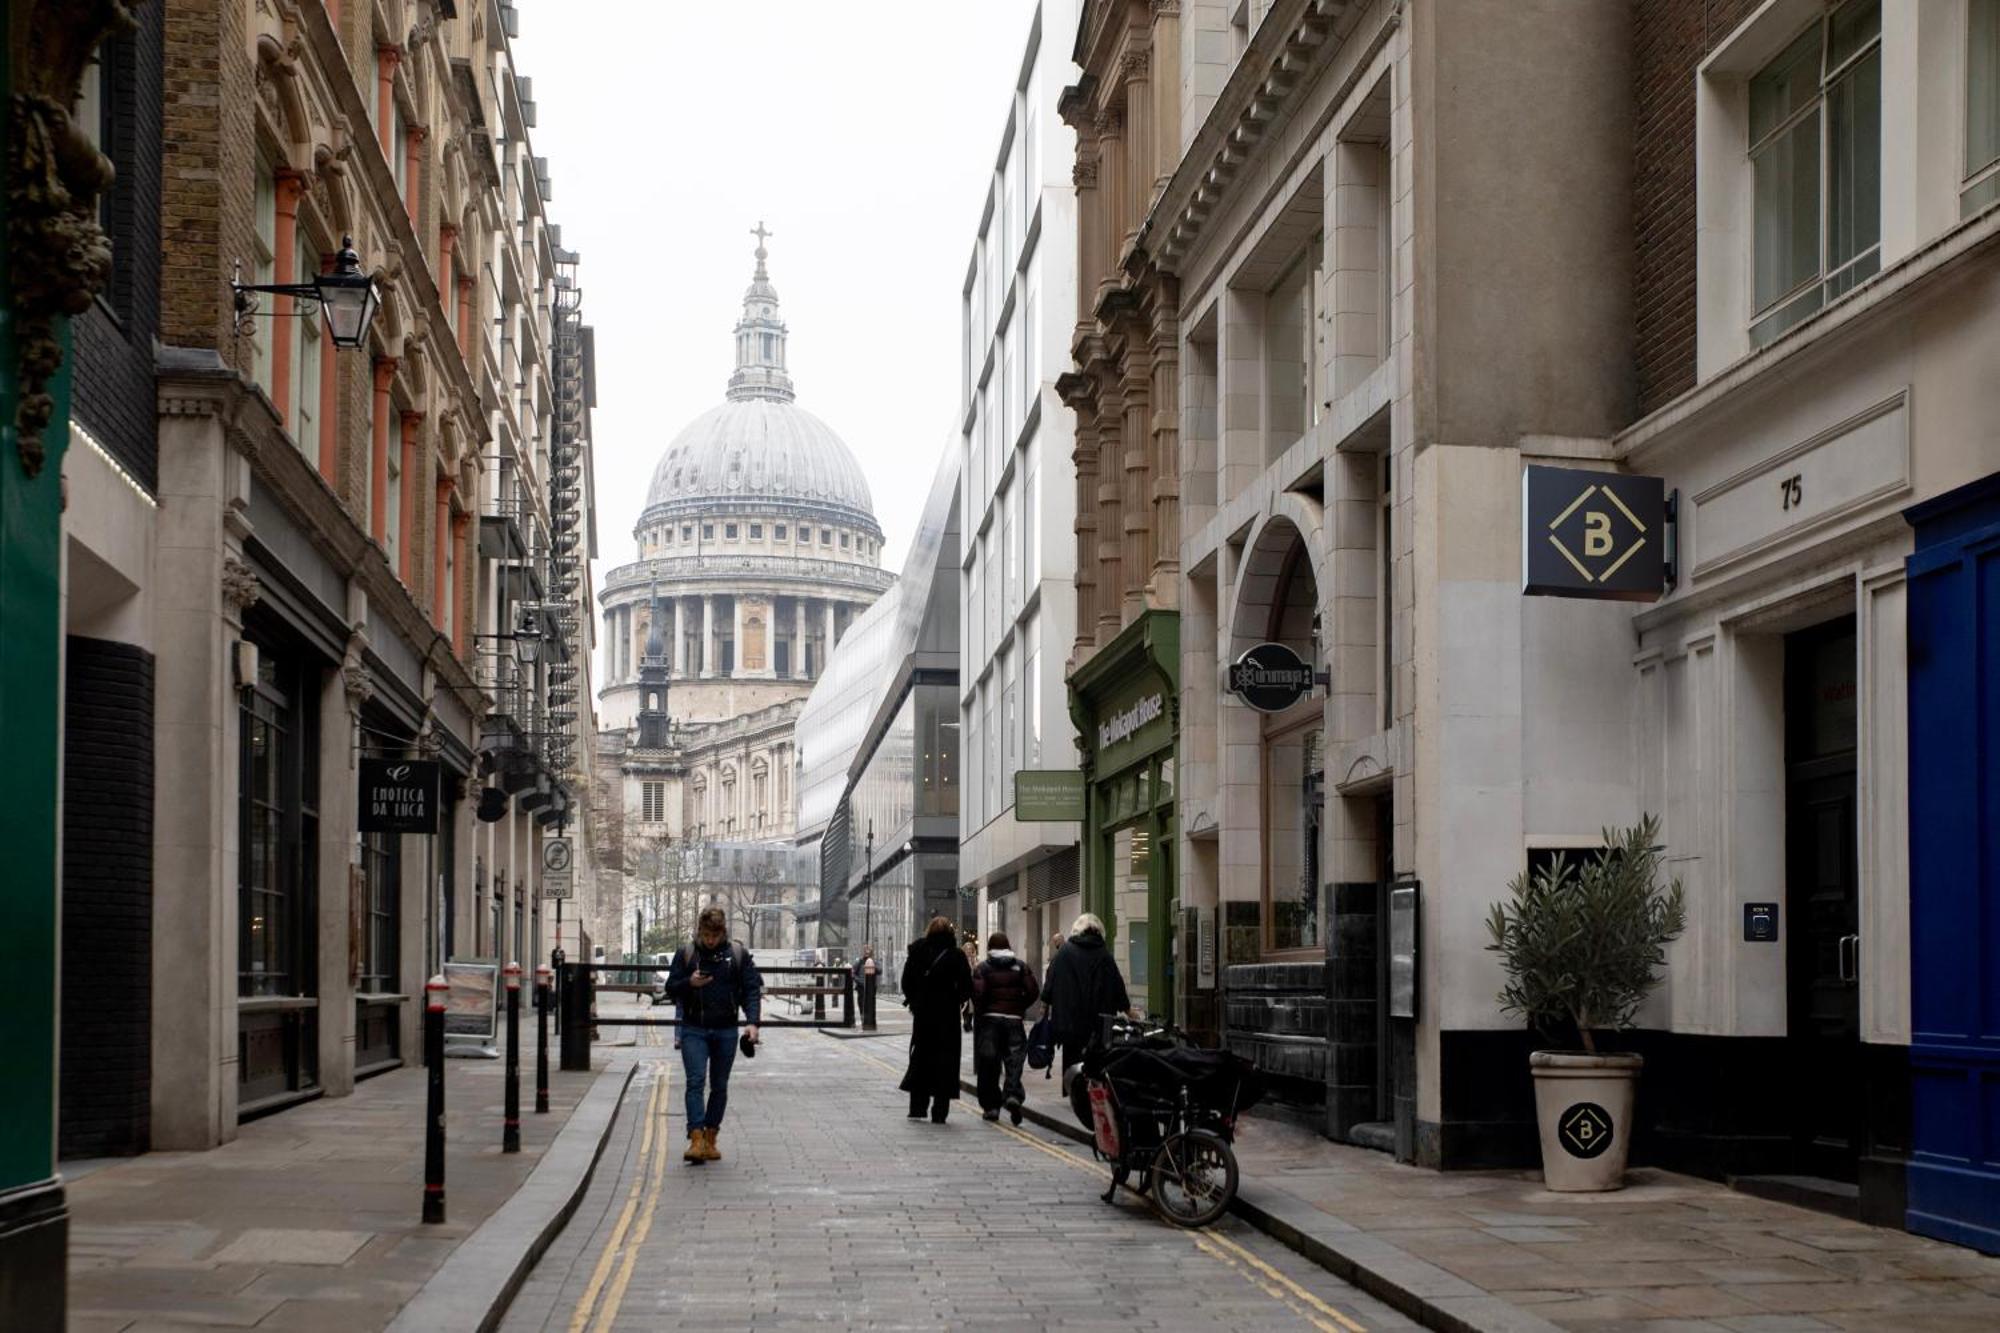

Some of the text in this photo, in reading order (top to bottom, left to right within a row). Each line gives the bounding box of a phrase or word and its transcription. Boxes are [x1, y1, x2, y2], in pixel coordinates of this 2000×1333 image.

[1781, 474, 1802, 511] 75
[1584, 511, 1614, 556] B
[1099, 722, 1111, 751] The
[373, 802, 387, 816] DA
[1581, 1120, 1593, 1139] B
